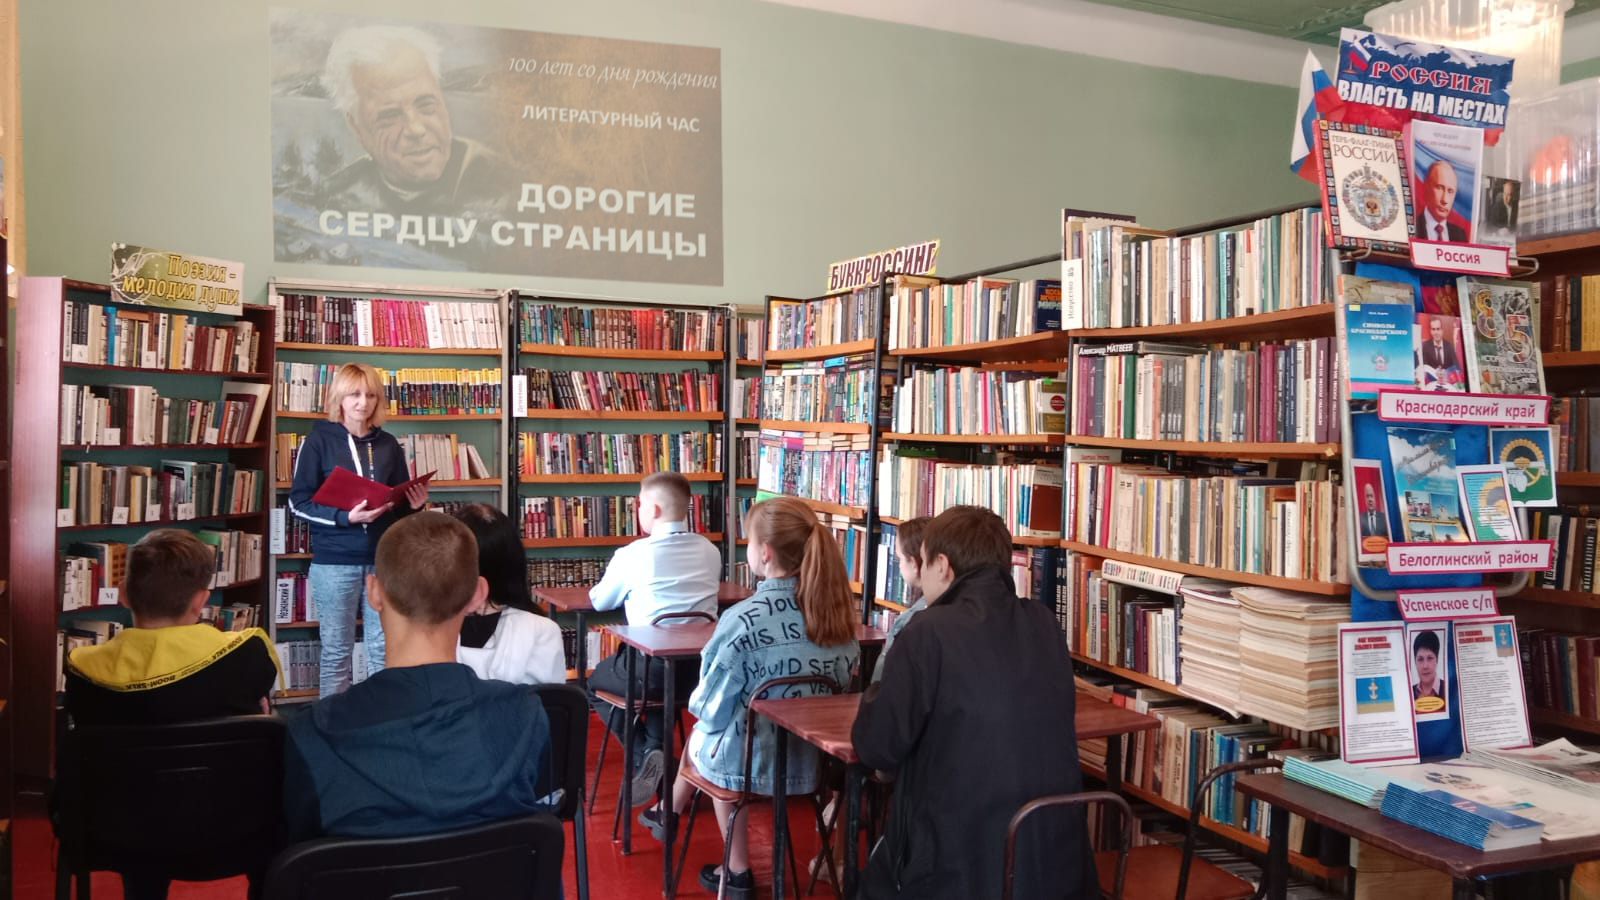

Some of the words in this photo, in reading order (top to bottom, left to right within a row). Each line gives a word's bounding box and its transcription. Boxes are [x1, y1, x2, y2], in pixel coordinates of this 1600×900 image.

[509, 58, 537, 73] 100
[539, 60, 573, 76] лет
[577, 63, 597, 78] со
[597, 66, 631, 85] дня
[632, 68, 718, 90] рождения
[1369, 61, 1493, 95] РОССИЯ
[1337, 79, 1408, 110] ВЛАСТЬ
[1410, 91, 1435, 115] НА
[1438, 95, 1506, 125] МЕСТАХ
[522, 105, 662, 129] ЛИТЕРАТУРНЫЙ
[666, 117, 700, 132] ЧАС
[1333, 144, 1396, 164] РОССИИ
[517, 182, 695, 218] ДОРОГИЕ
[318, 209, 478, 247] СЕРДЦУ
[491, 221, 707, 260] СТРАНИЦЫ
[167, 254, 227, 283] Поэзия
[831, 243, 937, 291] БУККРОССИНГ
[1436, 248, 1481, 264] Россия
[122, 275, 197, 301] мелодия
[198, 285, 240, 312] души
[1396, 399, 1499, 419] Краснодарский
[1505, 403, 1536, 420] край
[1399, 551, 1492, 567] Белоглинский
[1498, 552, 1538, 568] район
[738, 607, 761, 631] IF
[752, 597, 800, 616] YOU
[1402, 598, 1469, 613] Успенское
[1473, 594, 1493, 612] с/п
[727, 628, 774, 653] THIS
[781, 622, 801, 640] IS
